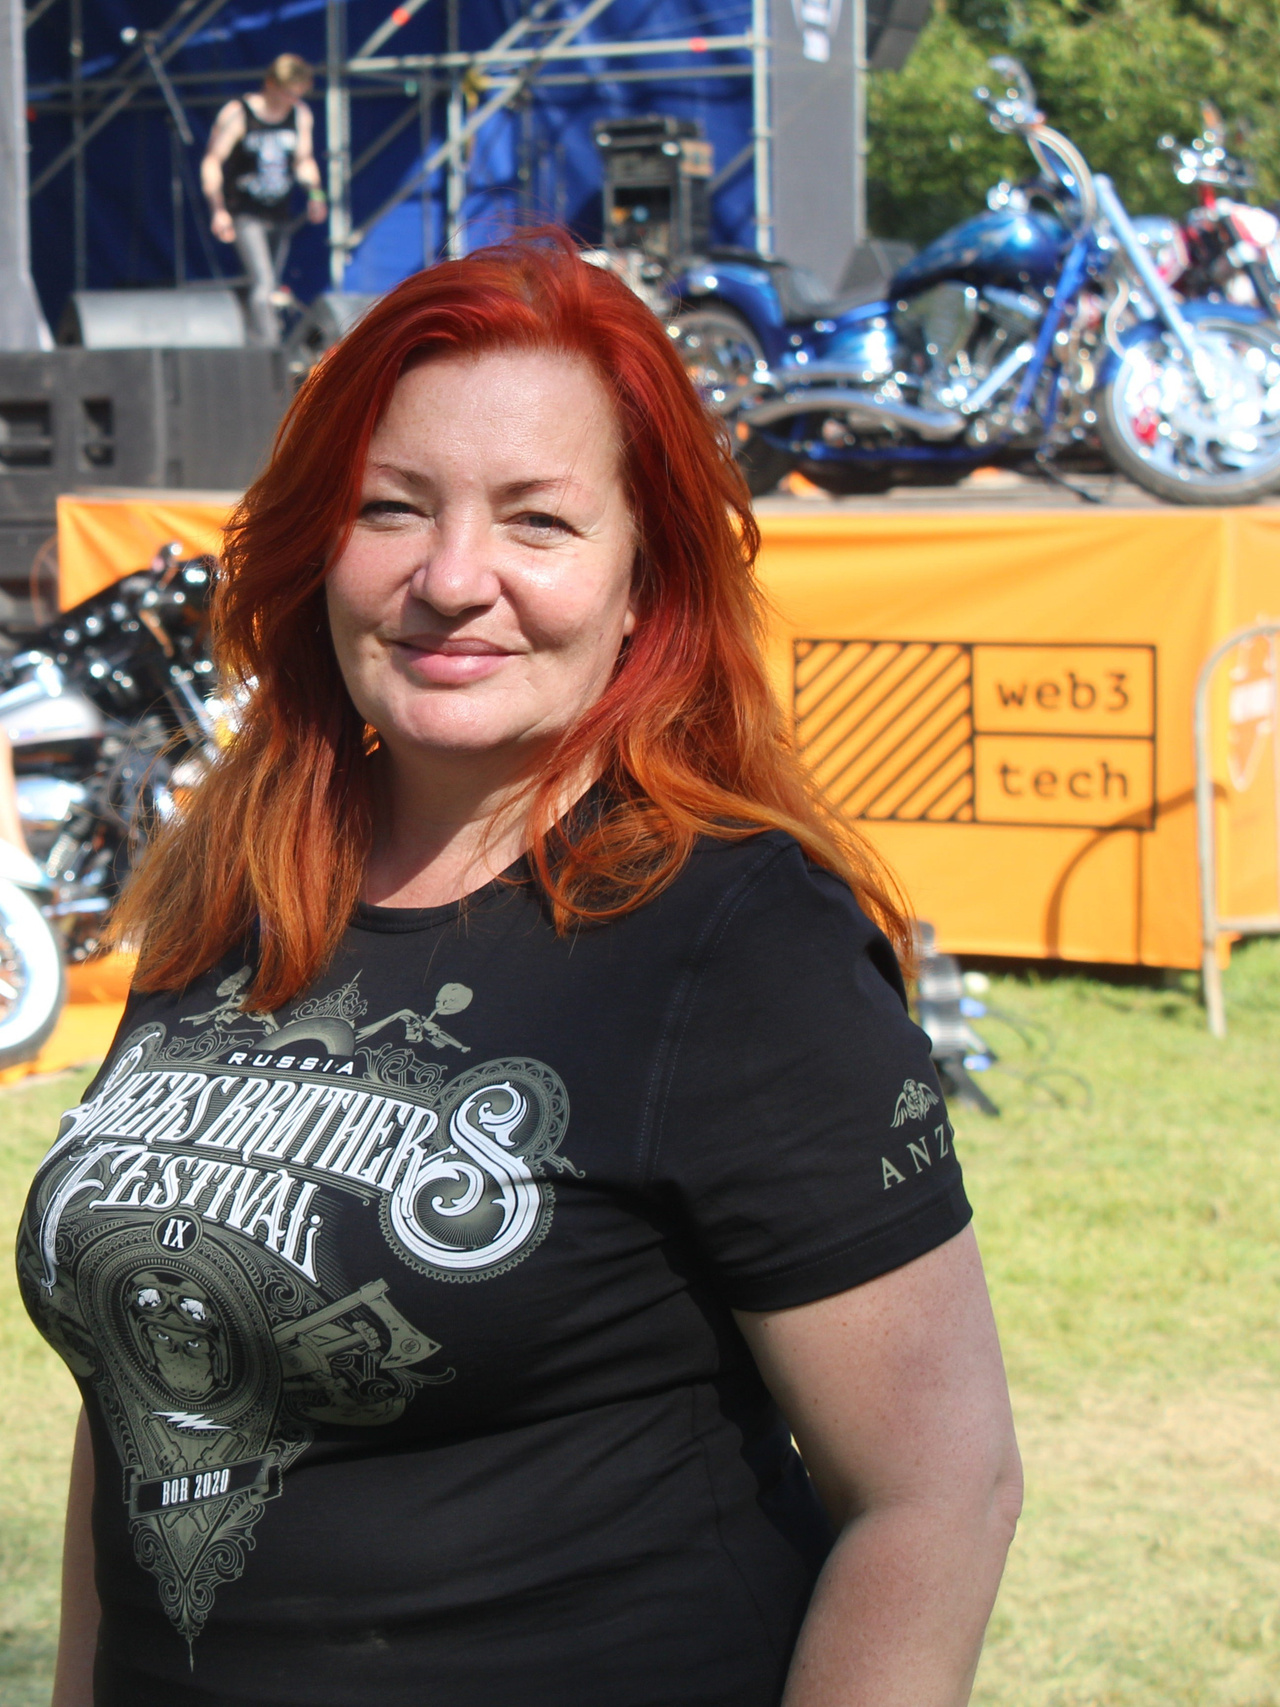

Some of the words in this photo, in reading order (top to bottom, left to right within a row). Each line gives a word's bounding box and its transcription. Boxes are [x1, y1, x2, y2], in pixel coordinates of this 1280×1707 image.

[997, 672, 1130, 712] web3
[998, 760, 1129, 800] tech
[881, 1118, 954, 1190] ANZ
[40, 1141, 323, 1296] FESTIVAL
[162, 1218, 191, 1249] IX
[194, 1468, 230, 1499] 2020
